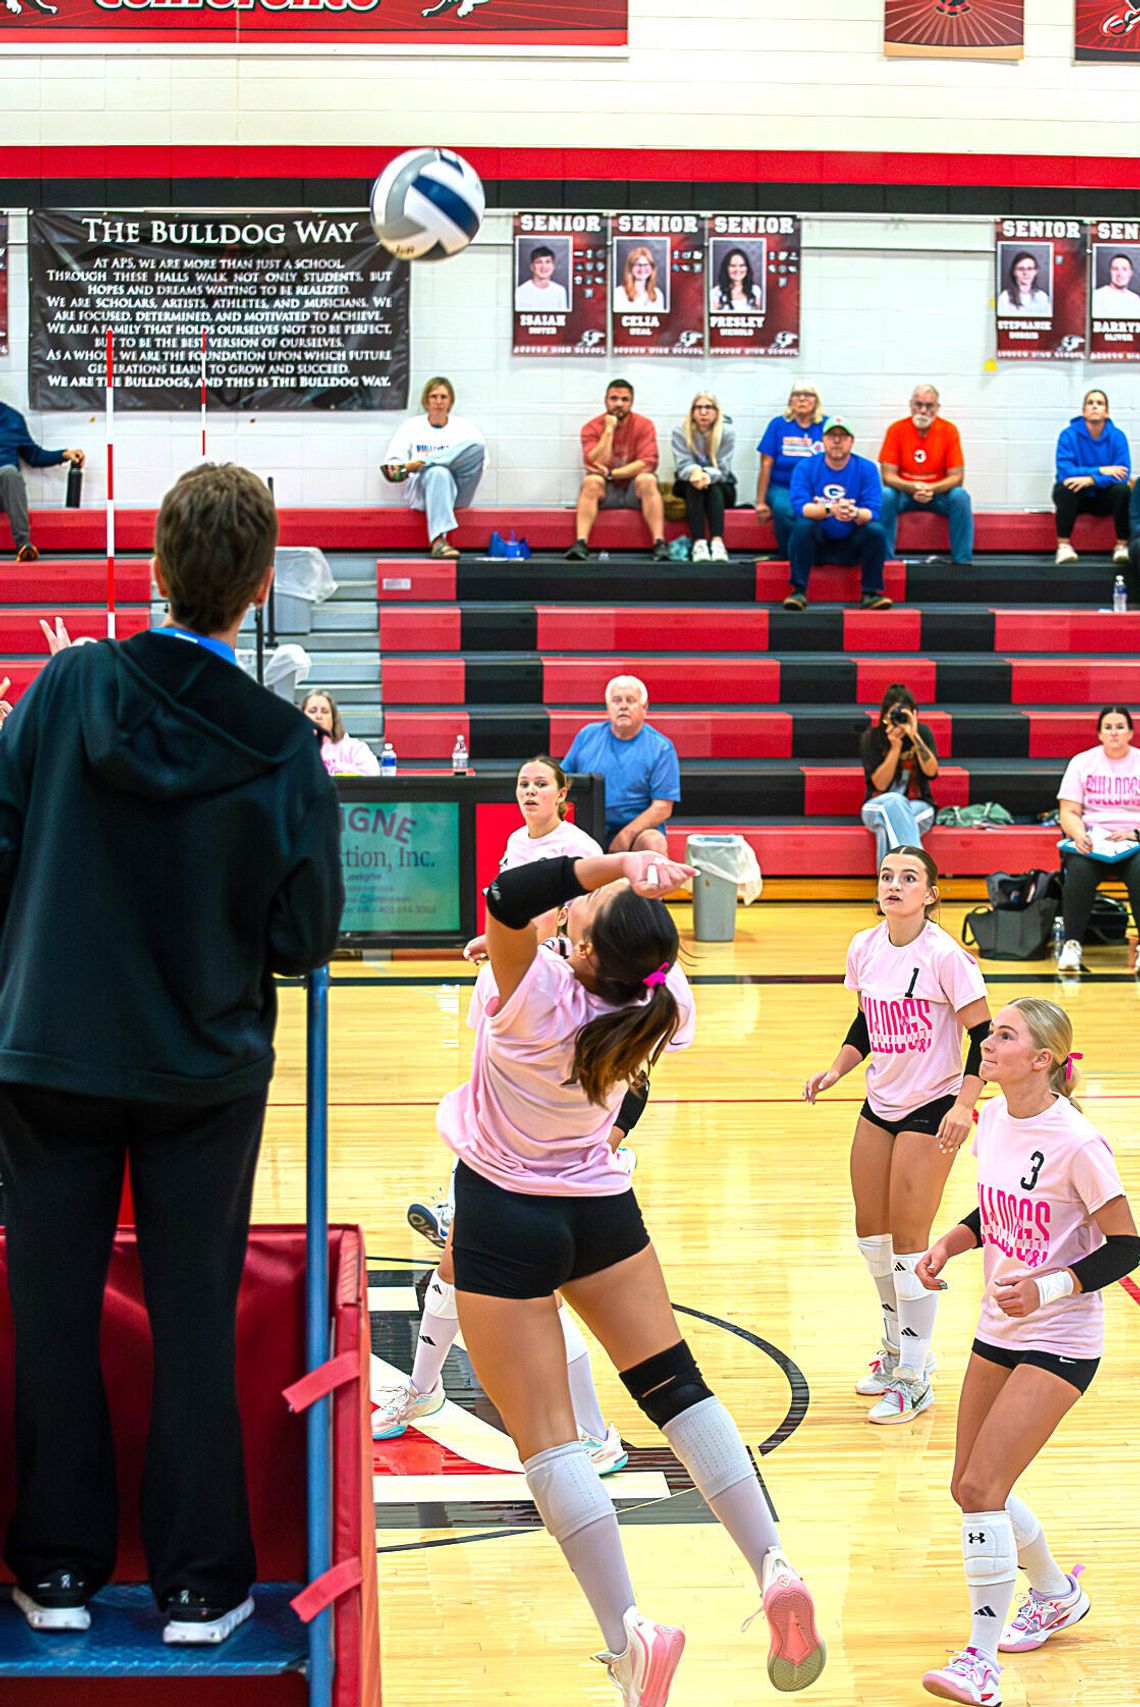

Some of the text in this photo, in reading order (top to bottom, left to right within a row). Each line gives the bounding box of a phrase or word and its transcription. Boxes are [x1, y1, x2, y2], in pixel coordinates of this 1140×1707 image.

[520, 215, 602, 233] SENIOR
[618, 215, 699, 234] SENIOR
[714, 216, 795, 235] SENIOR
[1002, 220, 1081, 239] SENIOR
[81, 218, 359, 244] THE BULLDOG WAY
[1097, 223, 1140, 240] SEN
[93, 258, 109, 268] AT
[138, 259, 156, 269] WE
[159, 259, 180, 268] ARE
[183, 259, 216, 269] MORE
[219, 259, 252, 269] THAN
[256, 259, 281, 269] JUST
[283, 260, 292, 269] A
[47, 270, 106, 281] THROUGH
[113, 272, 147, 282] THESE
[155, 272, 189, 282] HALLS
[195, 273, 227, 282] WALK
[233, 273, 259, 282] NOT
[265, 272, 297, 282] ONLY
[370, 271, 393, 282] BUT
[88, 284, 124, 295] HOPES
[127, 285, 153, 295] AND
[157, 285, 202, 295] DREAMS
[205, 285, 257, 295] WAITING
[260, 286, 276, 295] TO
[280, 286, 293, 295] BE
[46, 296, 66, 307] WE
[70, 298, 90, 308] ARE
[273, 298, 300, 308] AND
[372, 296, 392, 308] WE
[54, 310, 75, 321] ARE
[215, 312, 241, 321] AND
[244, 311, 310, 321] MOTIVATED
[311, 311, 329, 321] TO
[621, 316, 660, 327] CELIA
[709, 316, 765, 328] PRESLEY
[47, 322, 65, 334] WE
[67, 324, 89, 334] ARE
[91, 325, 99, 334] A
[143, 324, 174, 334] THAT
[217, 324, 279, 335] OURSELVES
[281, 324, 307, 334] NOT
[309, 324, 326, 334] TO
[329, 324, 341, 334] BE
[119, 338, 136, 348] TO
[139, 338, 151, 348] BE
[154, 338, 178, 348] THE
[208, 338, 259, 348] VERSION
[261, 338, 277, 348] OF
[46, 349, 61, 360] AS
[63, 351, 71, 360] A
[73, 350, 117, 361] WHOL,
[119, 351, 137, 361] WE
[139, 351, 160, 361] ARE
[162, 351, 185, 361] THE
[268, 351, 301, 360] UPON
[304, 350, 346, 361] WHICH
[348, 350, 392, 360] FUTURE
[87, 363, 167, 374] GEERATIONS
[209, 364, 226, 374] TO
[228, 364, 265, 374] GROW
[268, 364, 294, 374] AND
[47, 375, 68, 387] WE
[70, 376, 94, 387] ARE
[225, 376, 254, 387] THIS
[257, 376, 269, 387] IS
[270, 376, 297, 387] THE
[300, 376, 359, 387] BULLDOG
[340, 846, 435, 871] tion, Inc.
[904, 967, 920, 998] 1
[1020, 1150, 1045, 1191] 3
[977, 1182, 1051, 1264] LLDOGS
